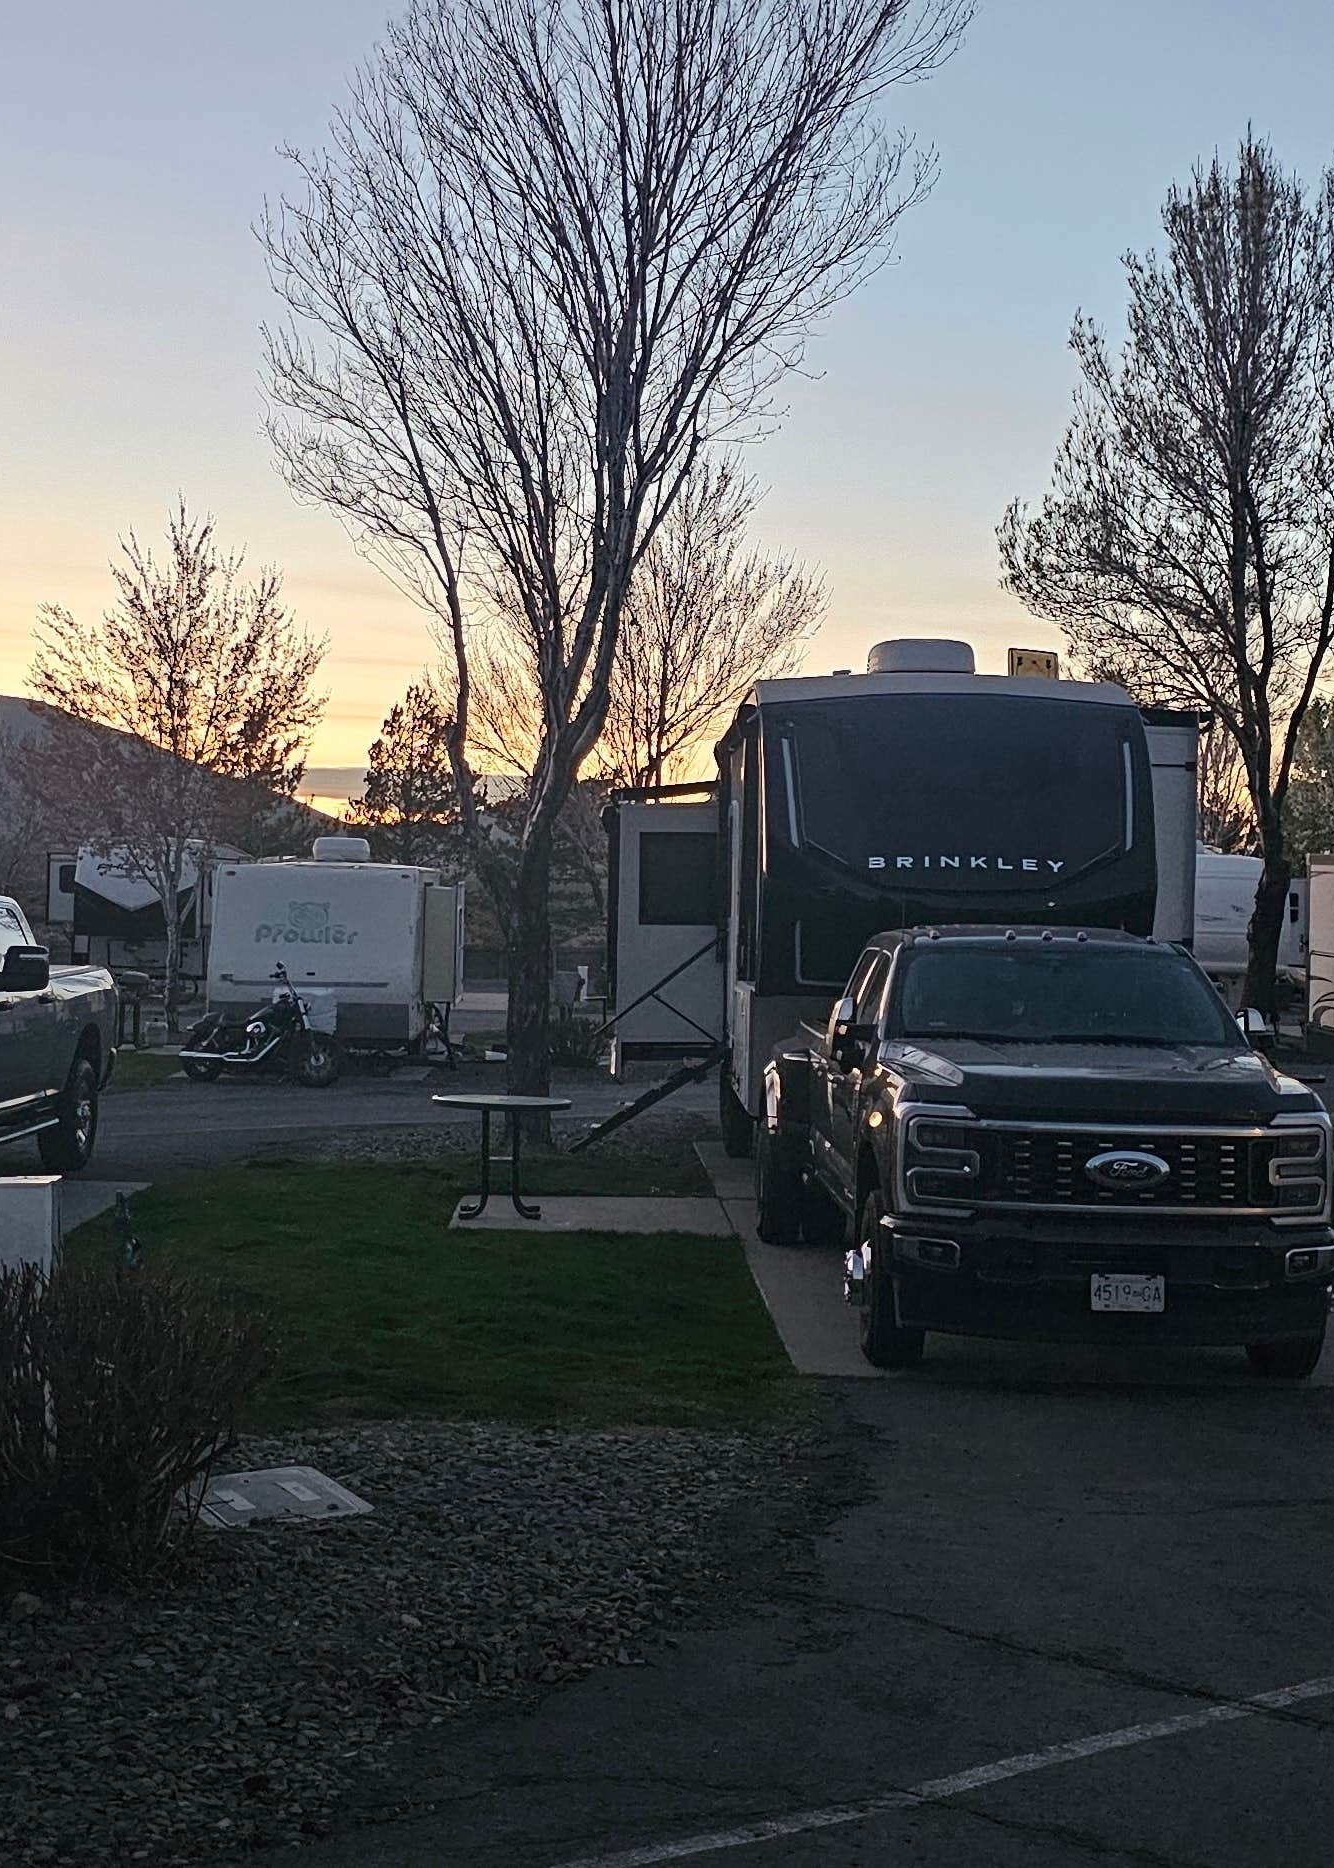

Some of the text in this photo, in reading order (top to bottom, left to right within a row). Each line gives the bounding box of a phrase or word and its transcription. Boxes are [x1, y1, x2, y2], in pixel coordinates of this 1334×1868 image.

[868, 855, 1065, 873] BRINKLEY
[254, 923, 359, 944] Prowler
[1109, 1160, 1150, 1179] Ford
